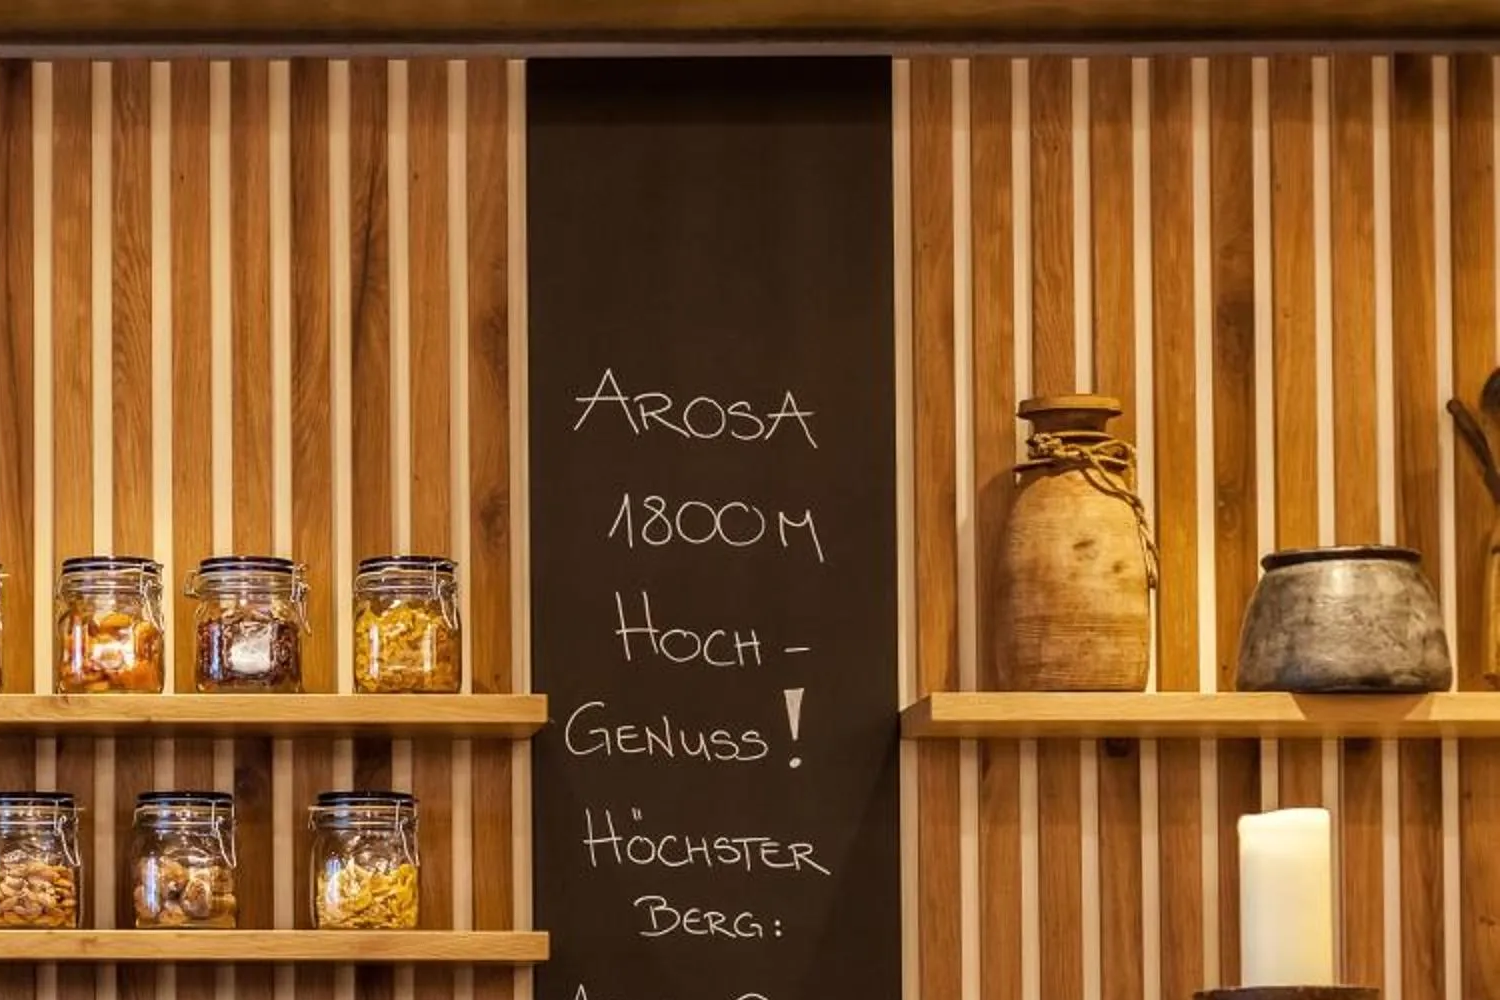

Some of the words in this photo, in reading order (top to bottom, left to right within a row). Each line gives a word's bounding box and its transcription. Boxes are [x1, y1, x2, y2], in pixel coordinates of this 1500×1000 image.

[574, 368, 818, 449] AROSA
[583, 807, 831, 876] HÖCHSTER
[633, 895, 782, 938] BERG:
